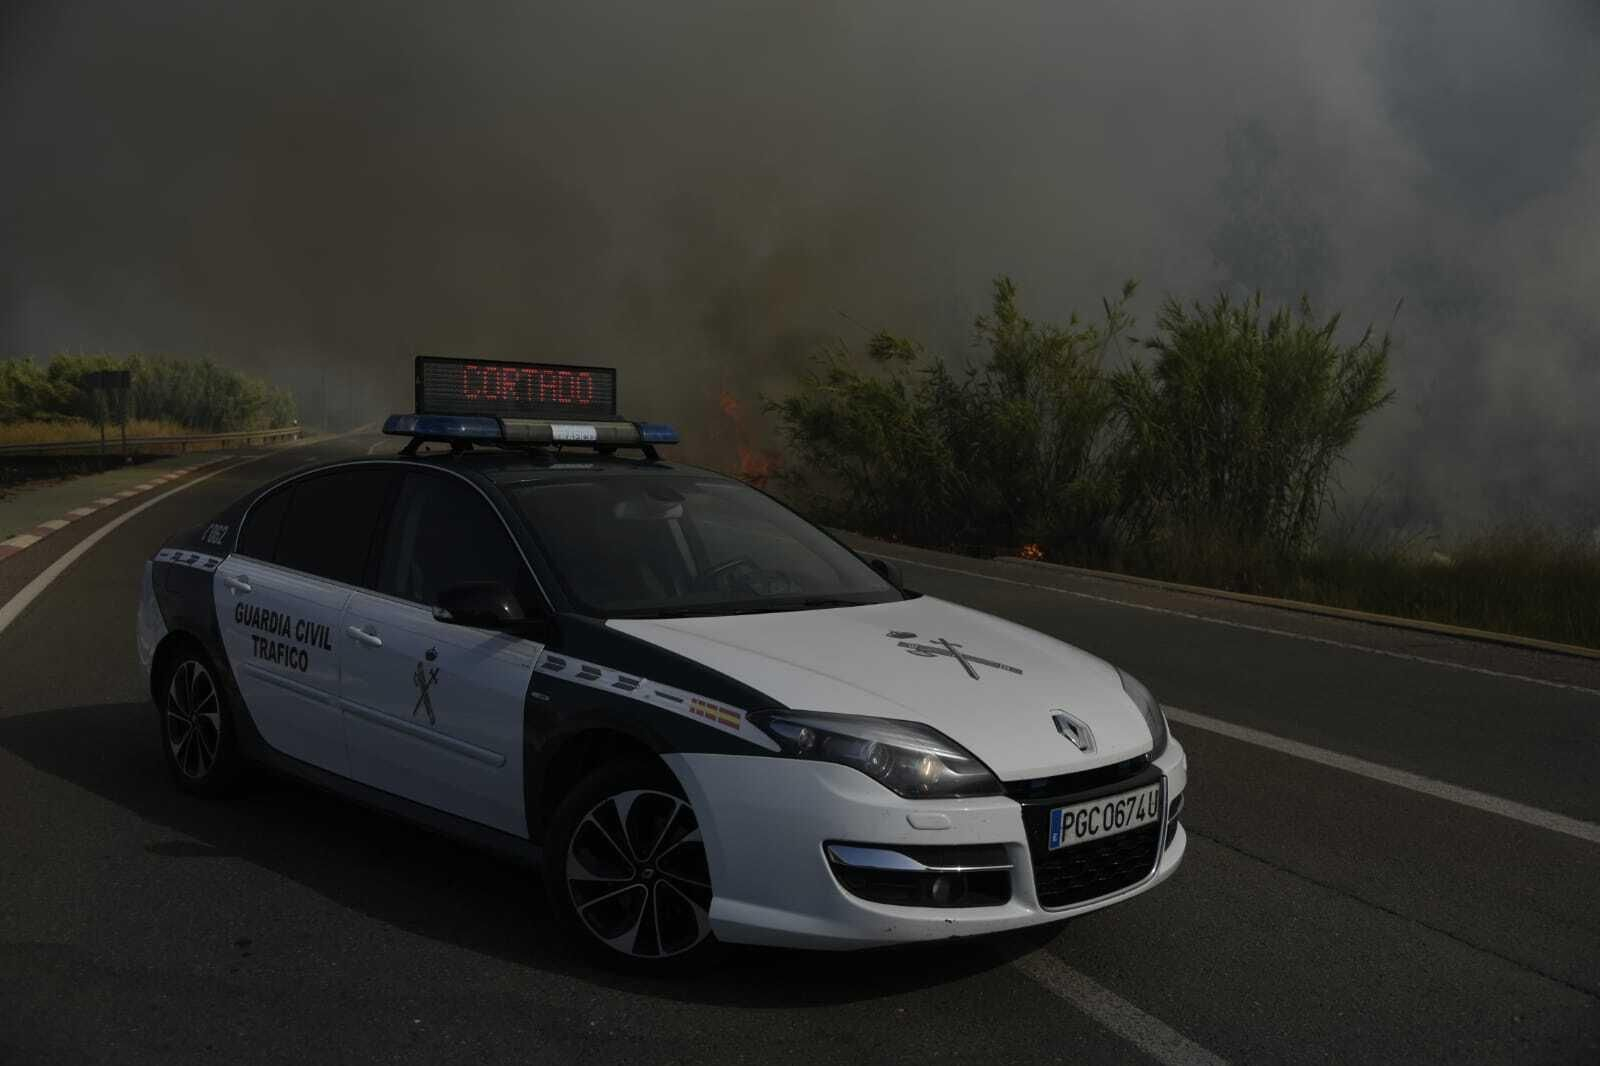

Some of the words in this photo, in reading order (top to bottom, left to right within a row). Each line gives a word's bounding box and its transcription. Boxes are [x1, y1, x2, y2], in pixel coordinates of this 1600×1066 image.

[463, 363, 593, 406] CORTADO
[235, 601, 291, 637] GUARDIA
[296, 617, 332, 652] CIVIL
[252, 633, 308, 673] TRAFICO
